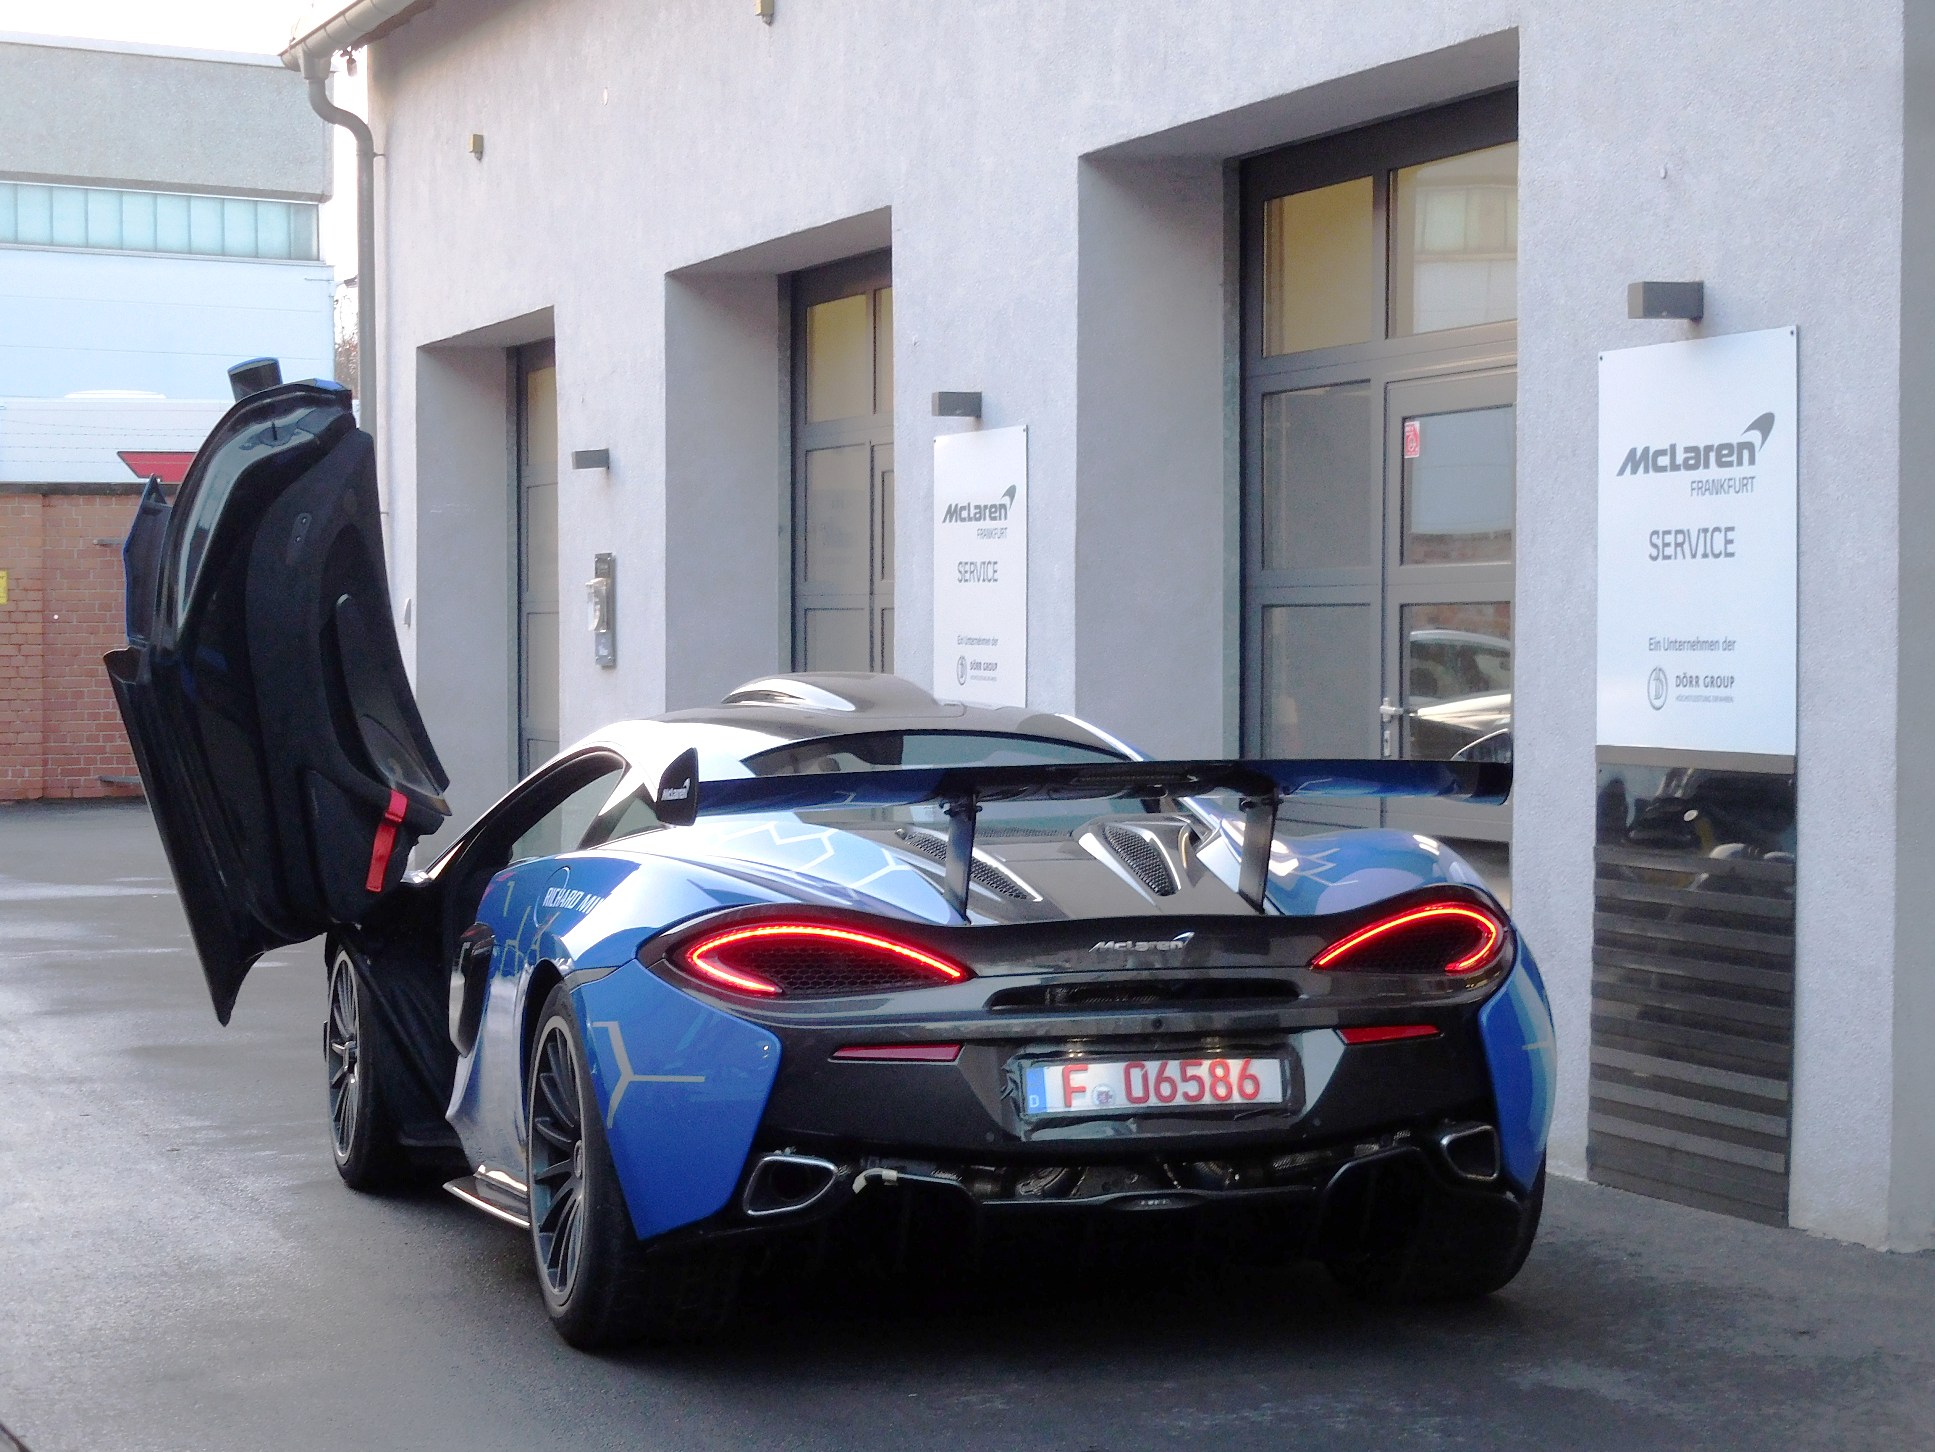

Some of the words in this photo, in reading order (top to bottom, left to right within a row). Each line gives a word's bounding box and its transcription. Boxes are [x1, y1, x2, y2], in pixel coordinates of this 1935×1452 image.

[1616, 439, 1756, 477] McLaren
[1690, 476, 1756, 497] FRANKFURT
[942, 502, 1008, 524] McLaren
[1648, 526, 1736, 562] SERVICE
[957, 560, 999, 584] SERVICE
[1648, 637, 1662, 651] Ein
[1663, 636, 1720, 651] Unternehmen
[1721, 636, 1736, 651] der
[1675, 672, 1700, 688] DÖRR
[1703, 675, 1735, 688] GROUP
[542, 887, 585, 909] RICHARD
[1088, 940, 1184, 953] McLaren
[1062, 1064, 1089, 1109] F
[1123, 1058, 1261, 1105] 06586
[1029, 1095, 1040, 1108] D
